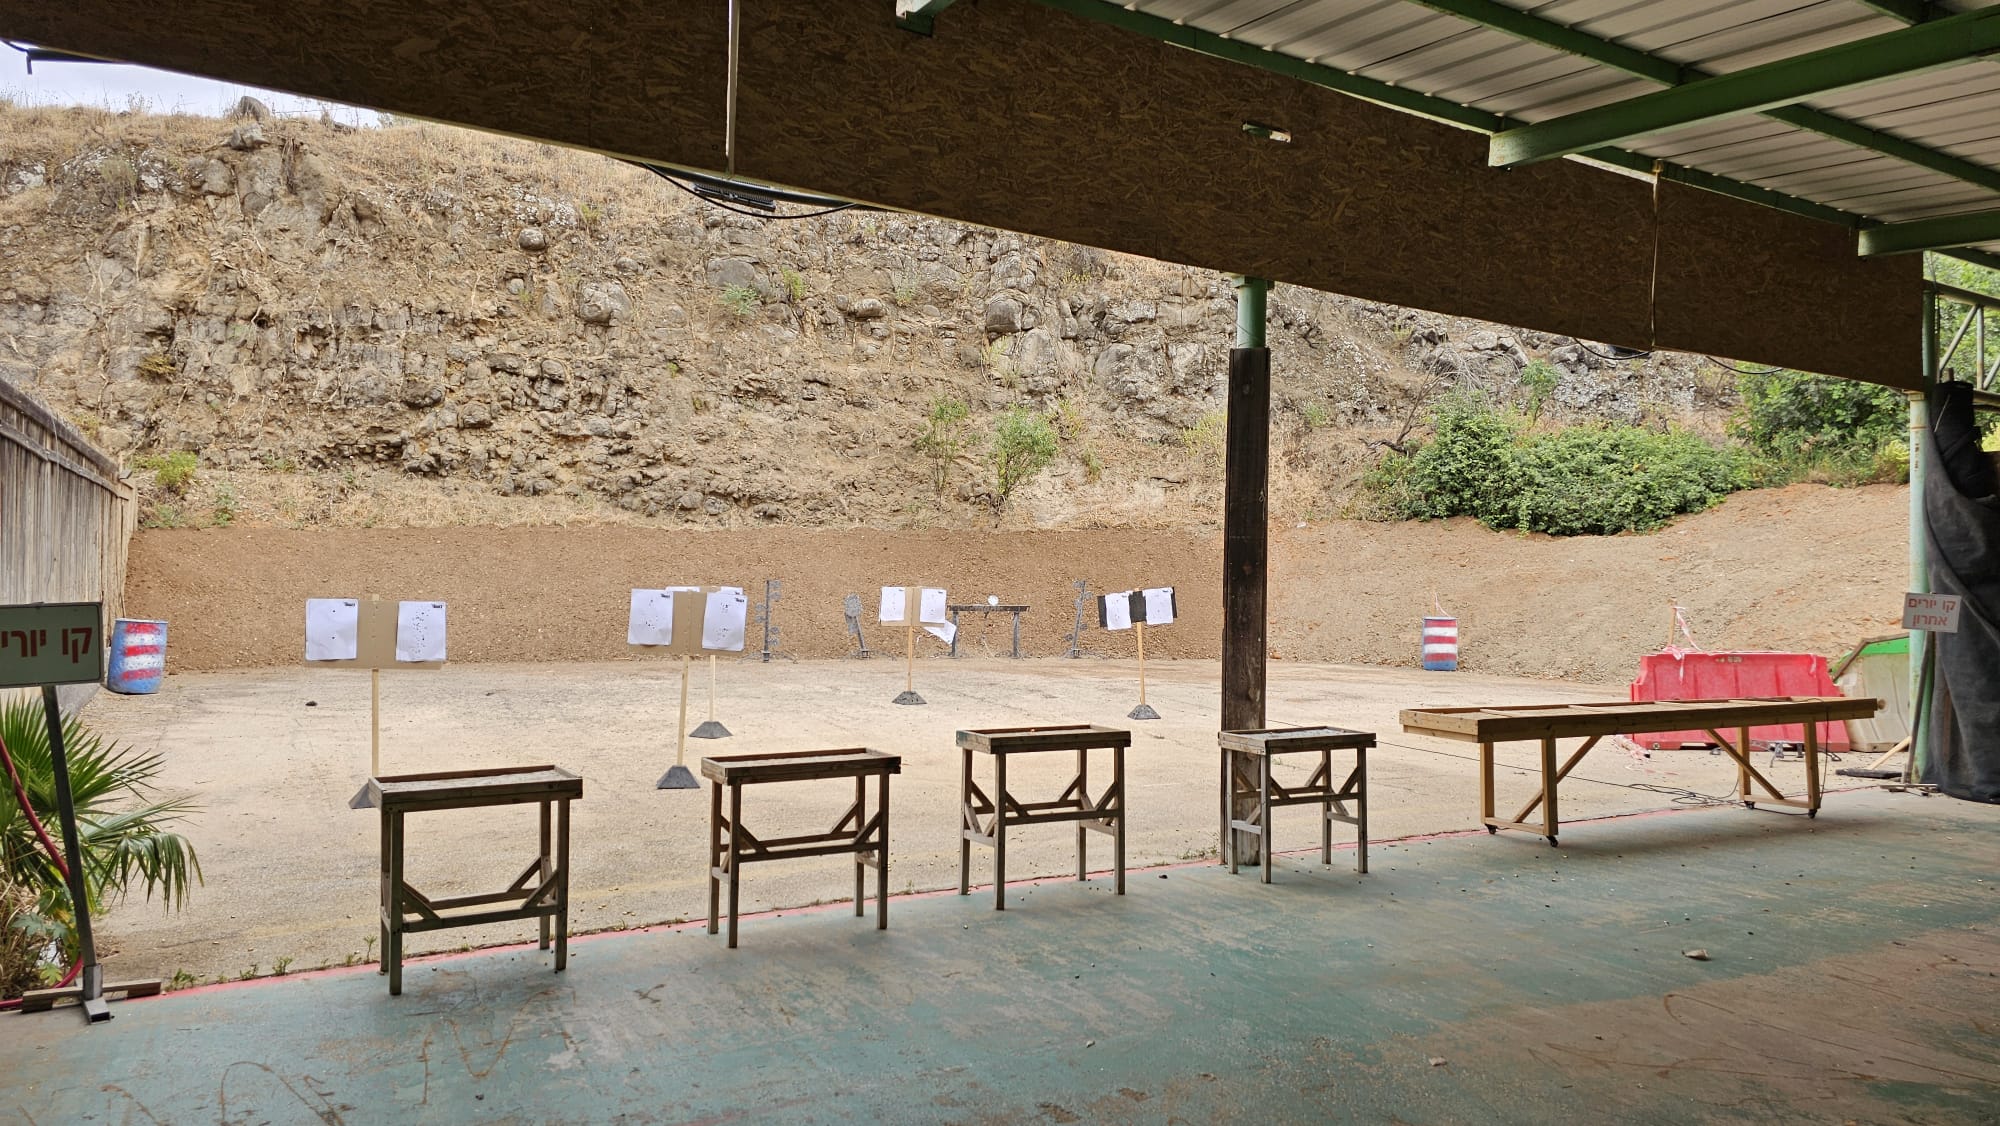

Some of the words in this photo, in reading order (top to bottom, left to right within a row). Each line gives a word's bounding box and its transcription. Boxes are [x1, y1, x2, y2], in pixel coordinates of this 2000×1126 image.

[1908, 598, 1937, 609] יורים
[1942, 600, 1956, 613] קו
[1912, 614, 1948, 627] אחרון
[1, 629, 46, 657] יורי
[62, 627, 92, 664] קו
